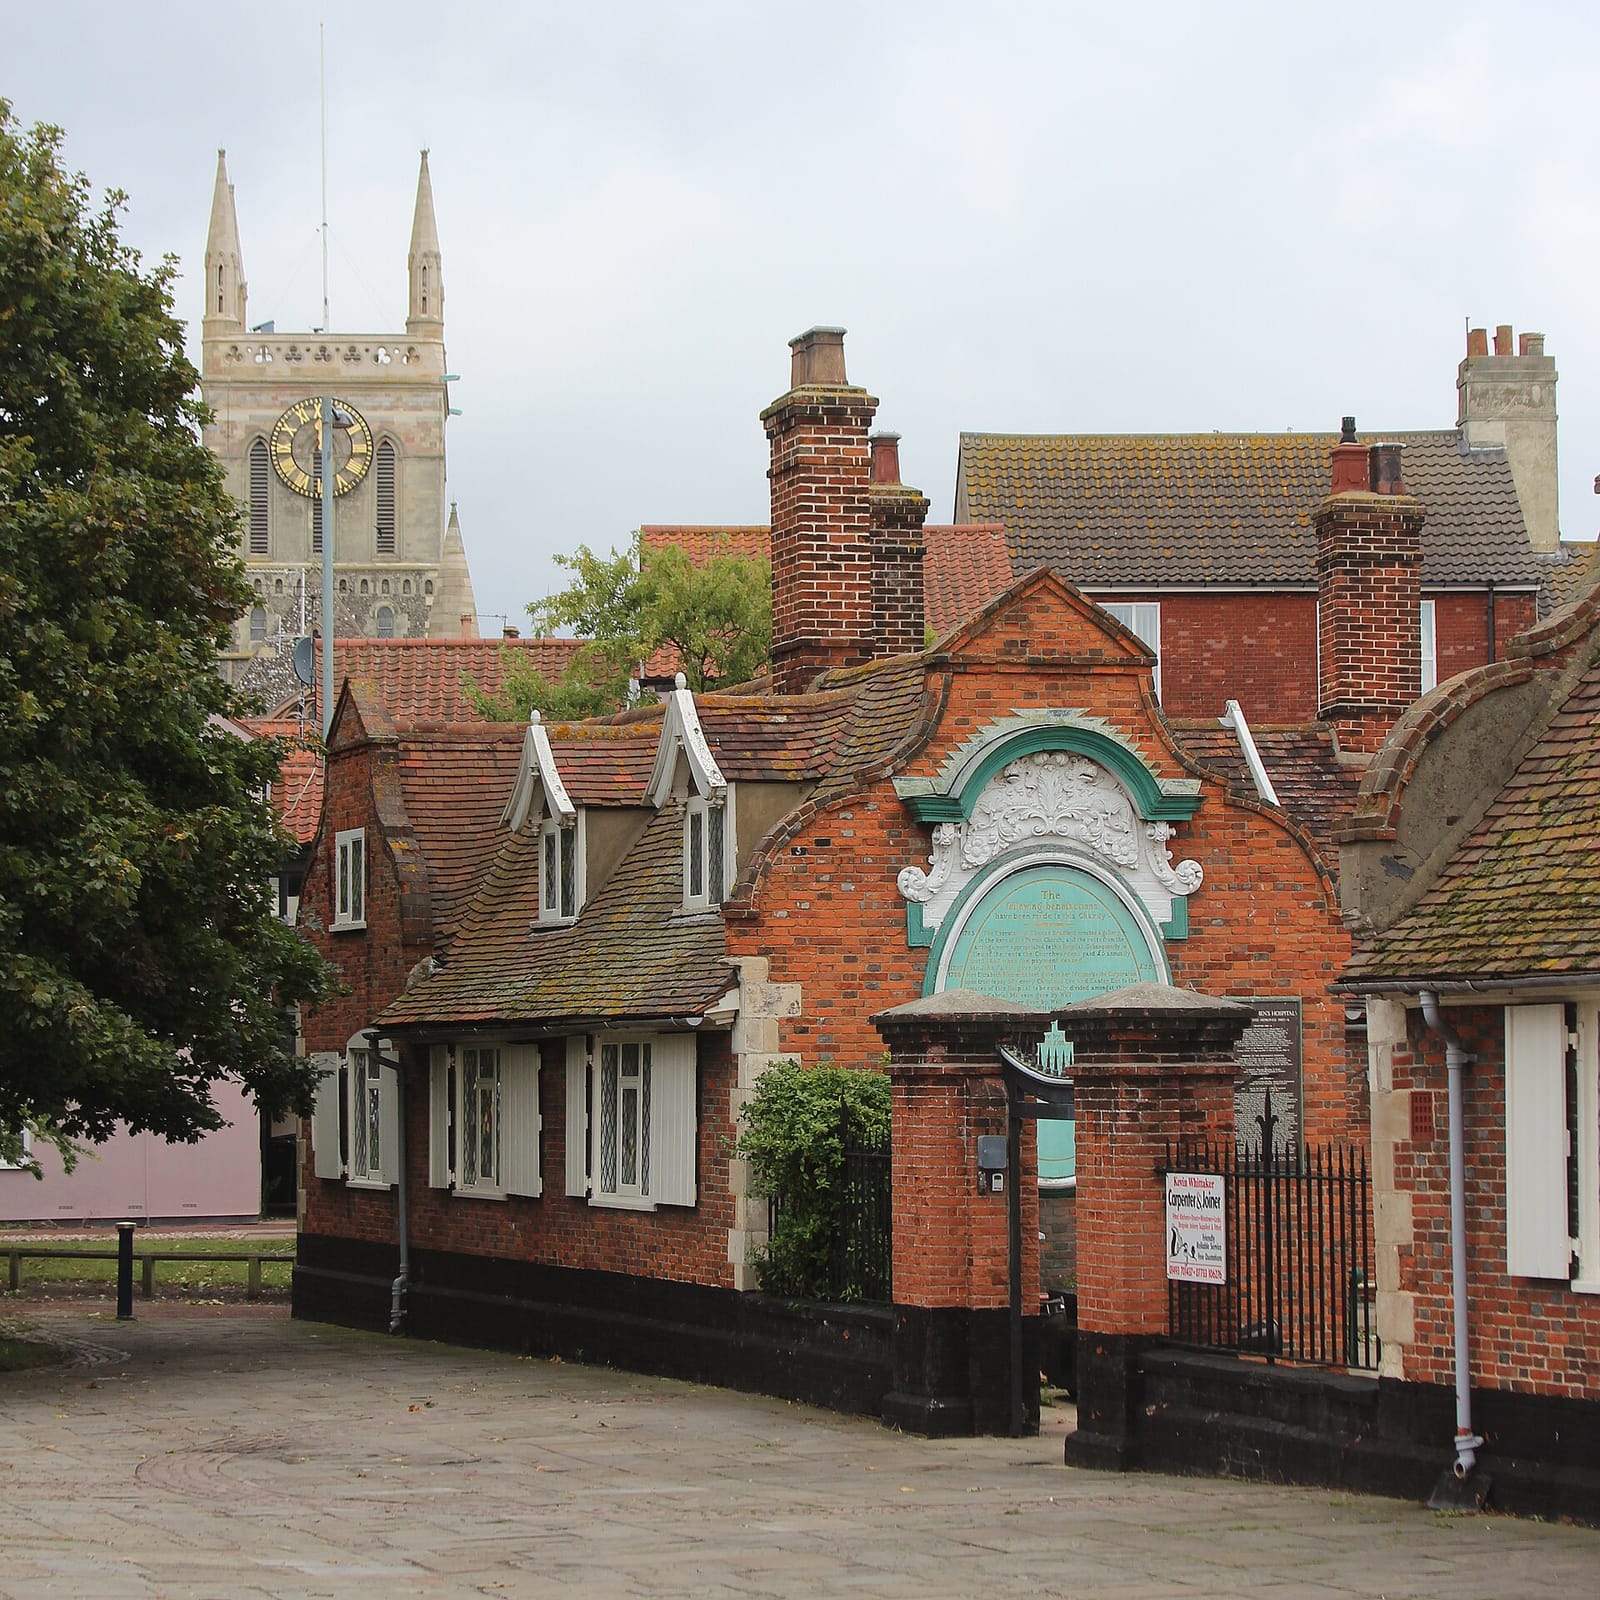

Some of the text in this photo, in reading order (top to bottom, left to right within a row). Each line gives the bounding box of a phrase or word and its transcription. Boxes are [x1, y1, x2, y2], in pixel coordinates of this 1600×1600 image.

[1041, 890, 1060, 900] The
[995, 912, 1012, 920] have
[1013, 912, 1031, 920] been
[1032, 912, 1051, 920] made
[1173, 1176, 1214, 1189] Kevin Whittaker
[1168, 1189, 1196, 1211] Carpenter
[1202, 1192, 1221, 1209] Joiner
